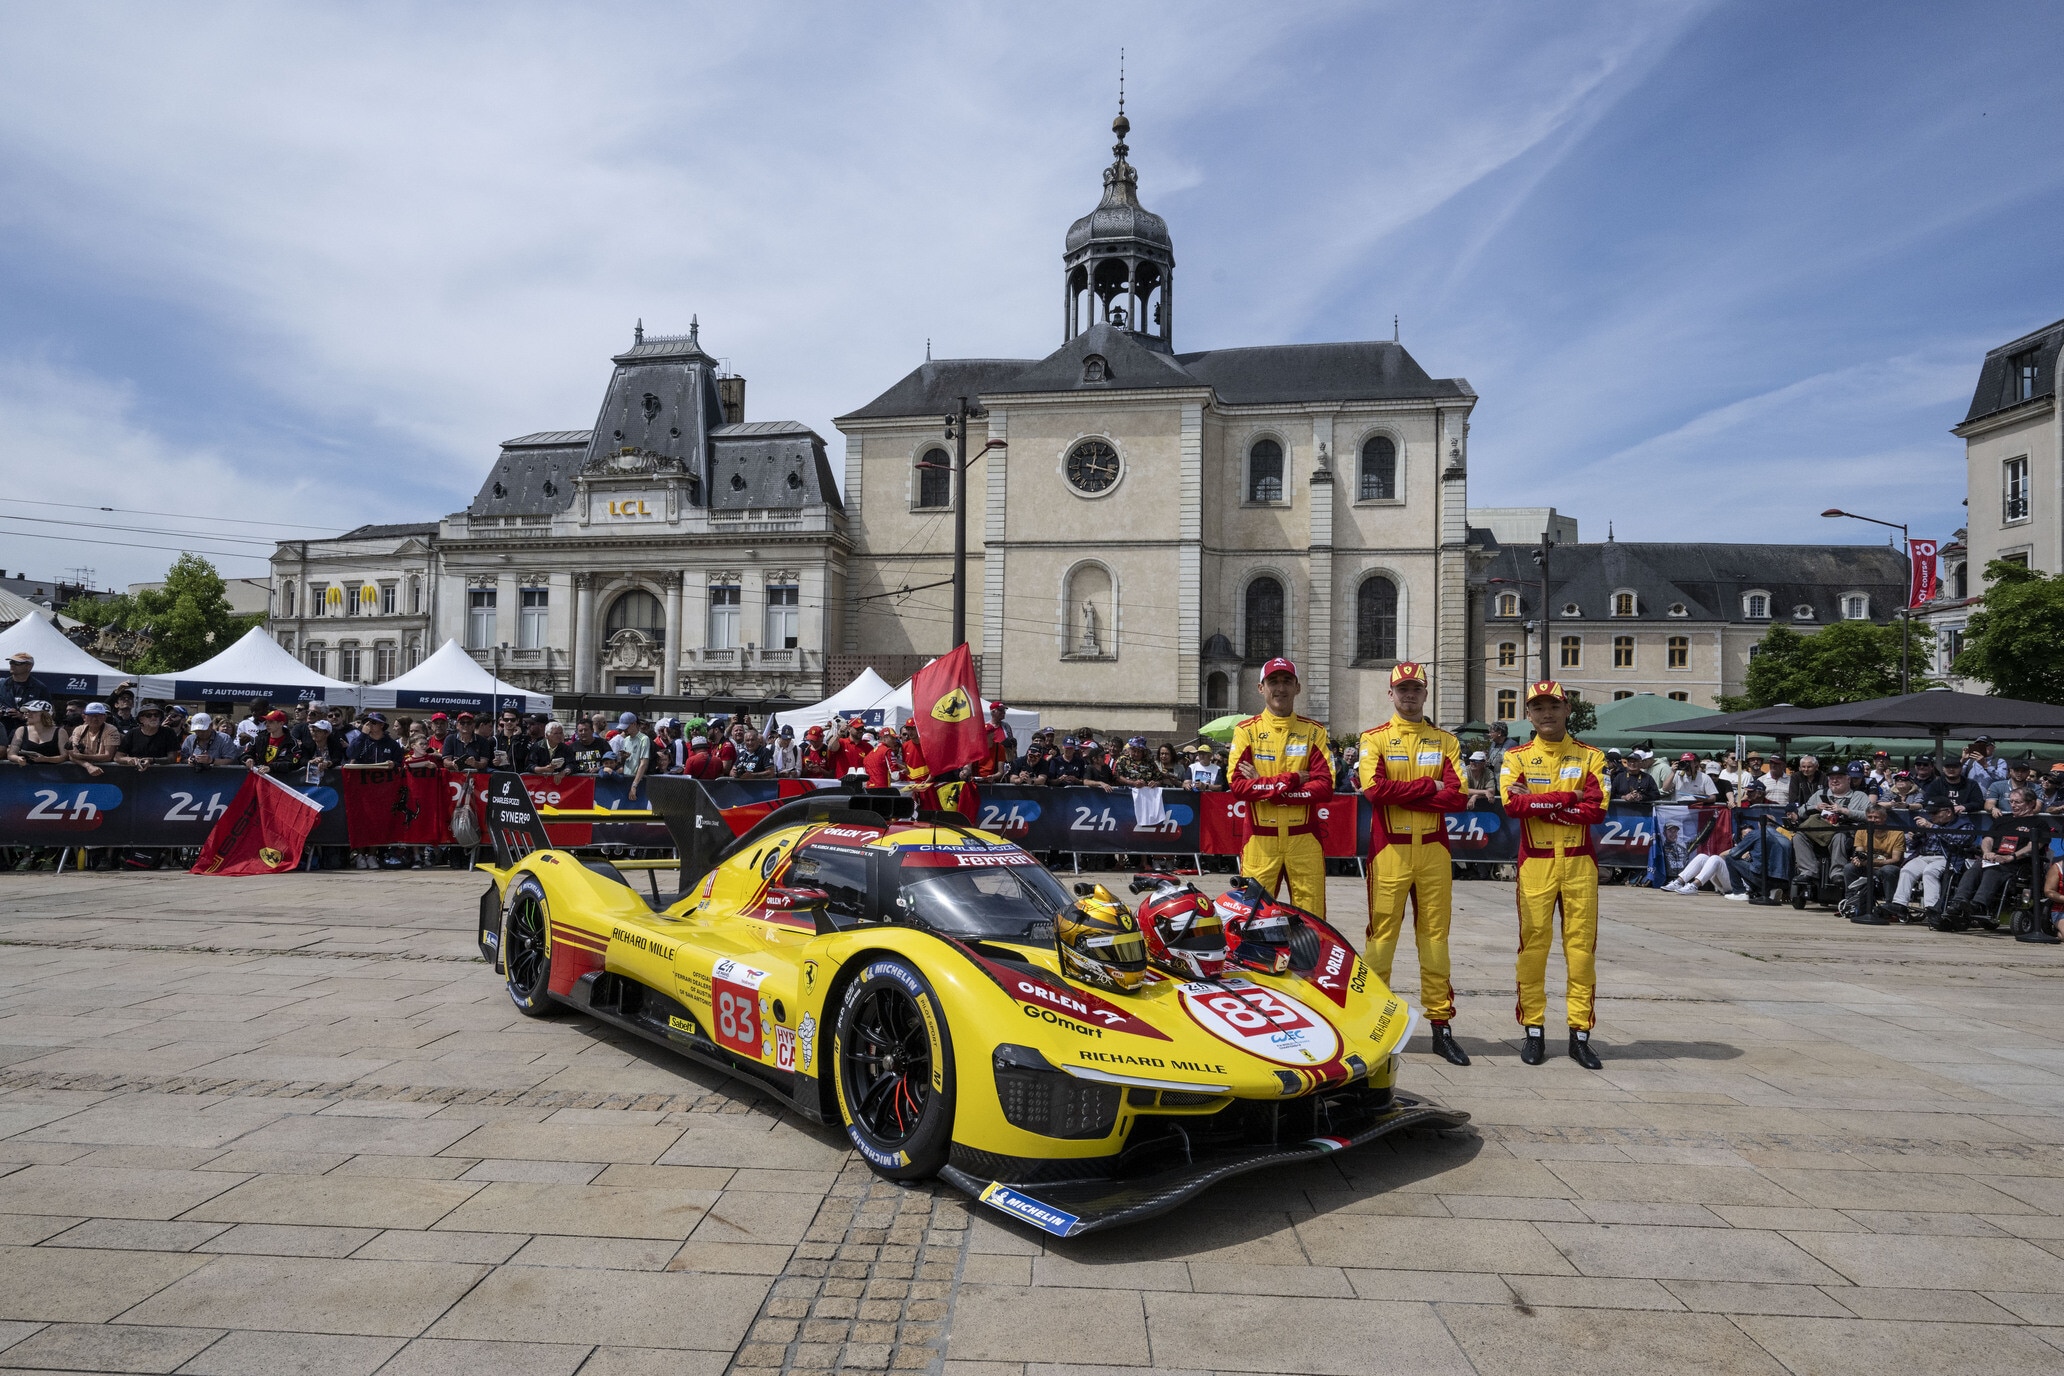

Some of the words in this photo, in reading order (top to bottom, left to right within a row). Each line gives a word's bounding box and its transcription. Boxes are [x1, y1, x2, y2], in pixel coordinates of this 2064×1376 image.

[609, 499, 652, 516] LCL
[1921, 560, 1929, 588] course
[68, 677, 88, 688] 24h
[214, 688, 274, 697] AUTOMOBILES
[299, 689, 316, 699] 24h
[419, 696, 429, 704] RS
[430, 697, 482, 706] AUTOMOBILES
[503, 698, 518, 707] 24h
[26, 789, 97, 820] 24h
[979, 805, 1026, 831] 24h
[1071, 806, 1117, 831] 24h
[823, 827, 862, 838] ORLEN
[1600, 821, 1651, 846] 24h
[954, 852, 1035, 866] Ferrari
[766, 896, 782, 905] ORLEN
[1222, 901, 1242, 911] ORLEN
[612, 927, 647, 950] RICHARD
[649, 941, 675, 961] MILLE
[1326, 945, 1347, 976] ORLEN
[675, 972, 693, 984] FERRARI
[692, 971, 712, 983] OFFICIAL
[874, 963, 918, 992] MICHELIN
[1350, 959, 1369, 994] GOmart
[1017, 980, 1087, 1014] ORLEN
[719, 991, 755, 1044] 83
[920, 999, 931, 1021] PILOT
[928, 1020, 938, 1048] SPORT
[1024, 1003, 1103, 1039] GOmart
[1209, 993, 1299, 1029] 83
[1369, 1015, 1391, 1043] RICHARD
[1383, 999, 1398, 1018] MILLE
[671, 1016, 693, 1033] Sabelt
[777, 1028, 796, 1045] HYP
[1270, 1030, 1306, 1044] WEC
[1079, 1050, 1165, 1068] RICHARD
[1171, 1060, 1228, 1074] MILLE
[851, 1130, 893, 1167] MICHELIN
[1006, 1197, 1066, 1227] MICHELIN
